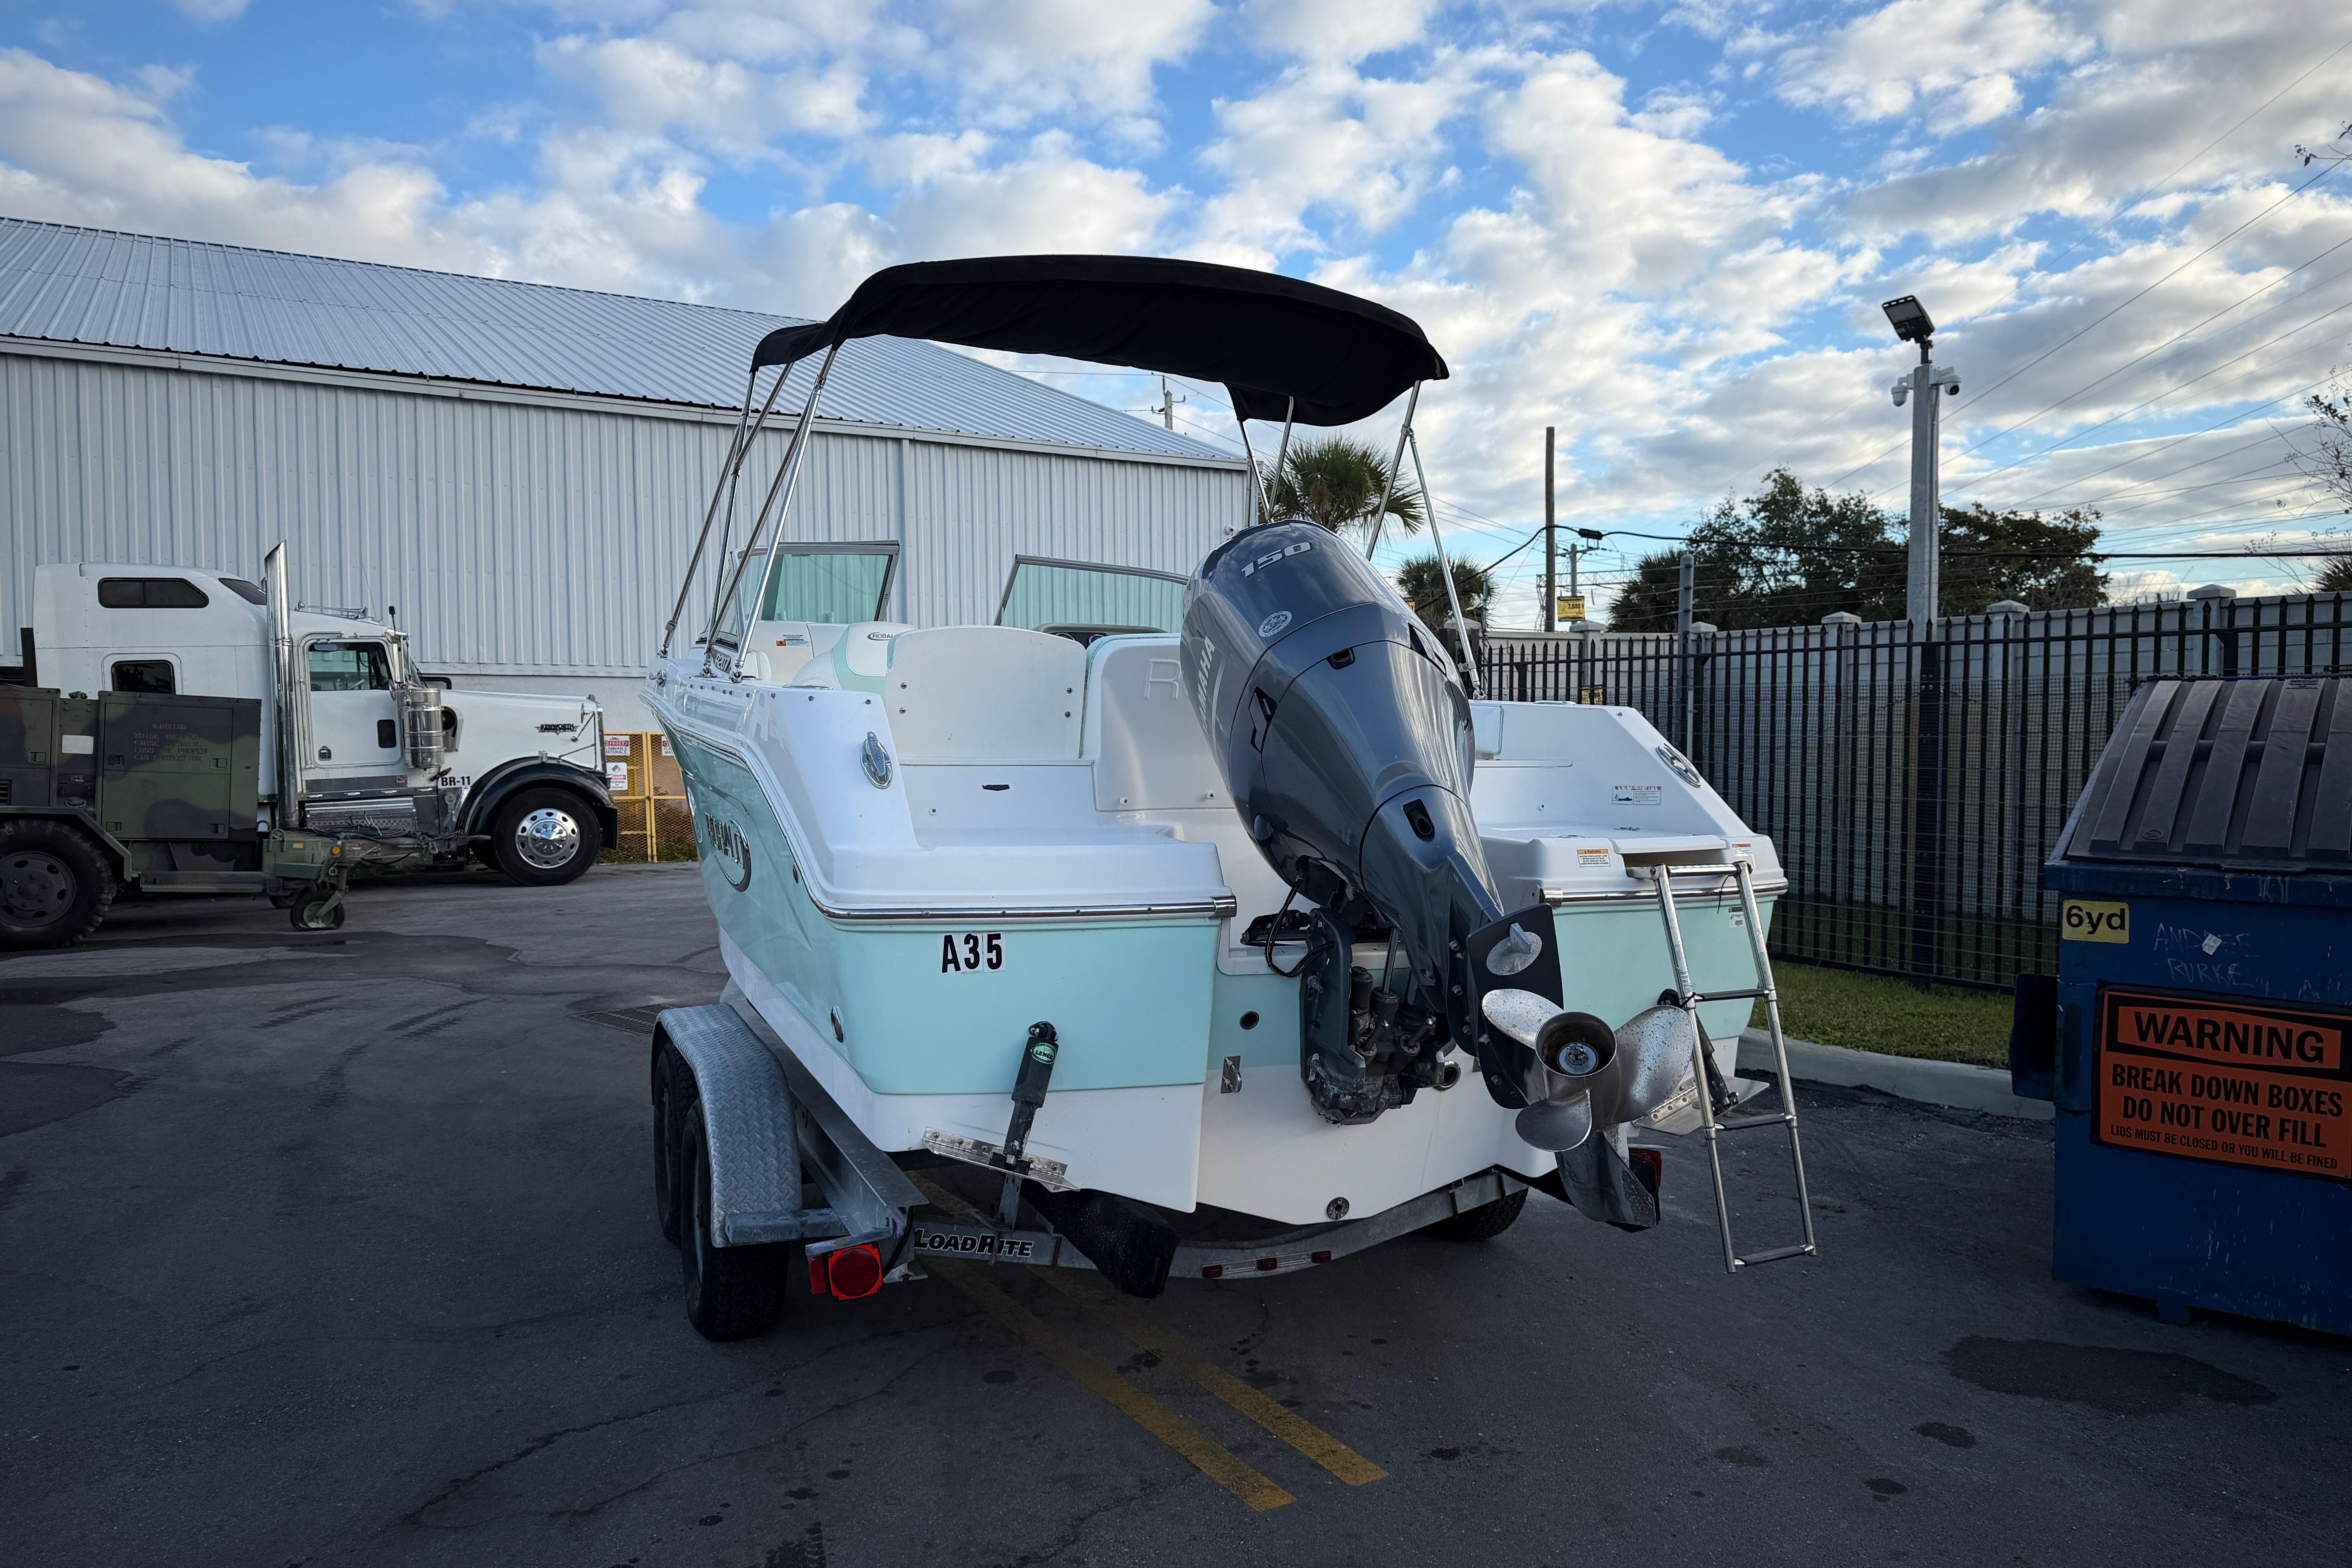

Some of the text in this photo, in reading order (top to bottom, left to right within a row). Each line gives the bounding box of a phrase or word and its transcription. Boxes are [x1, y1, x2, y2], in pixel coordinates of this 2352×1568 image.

[1241, 542, 1311, 577] 150
[441, 776, 470, 786] BR-11
[2066, 905, 2125, 935] 6yd
[942, 933, 1002, 973] A35
[1035, 1050, 1053, 1059] LENCO
[2134, 1011, 2324, 1064] WARNING
[2112, 1063, 2343, 1117] BREAK DOWN BOXES
[2123, 1096, 2326, 1148] DO NOT OVER FILL
[2111, 1124, 2338, 1169] LIDS MUST BE CLOSED OR YOU WILL BE FINED
[914, 1228, 1034, 1257] LOADRITE
